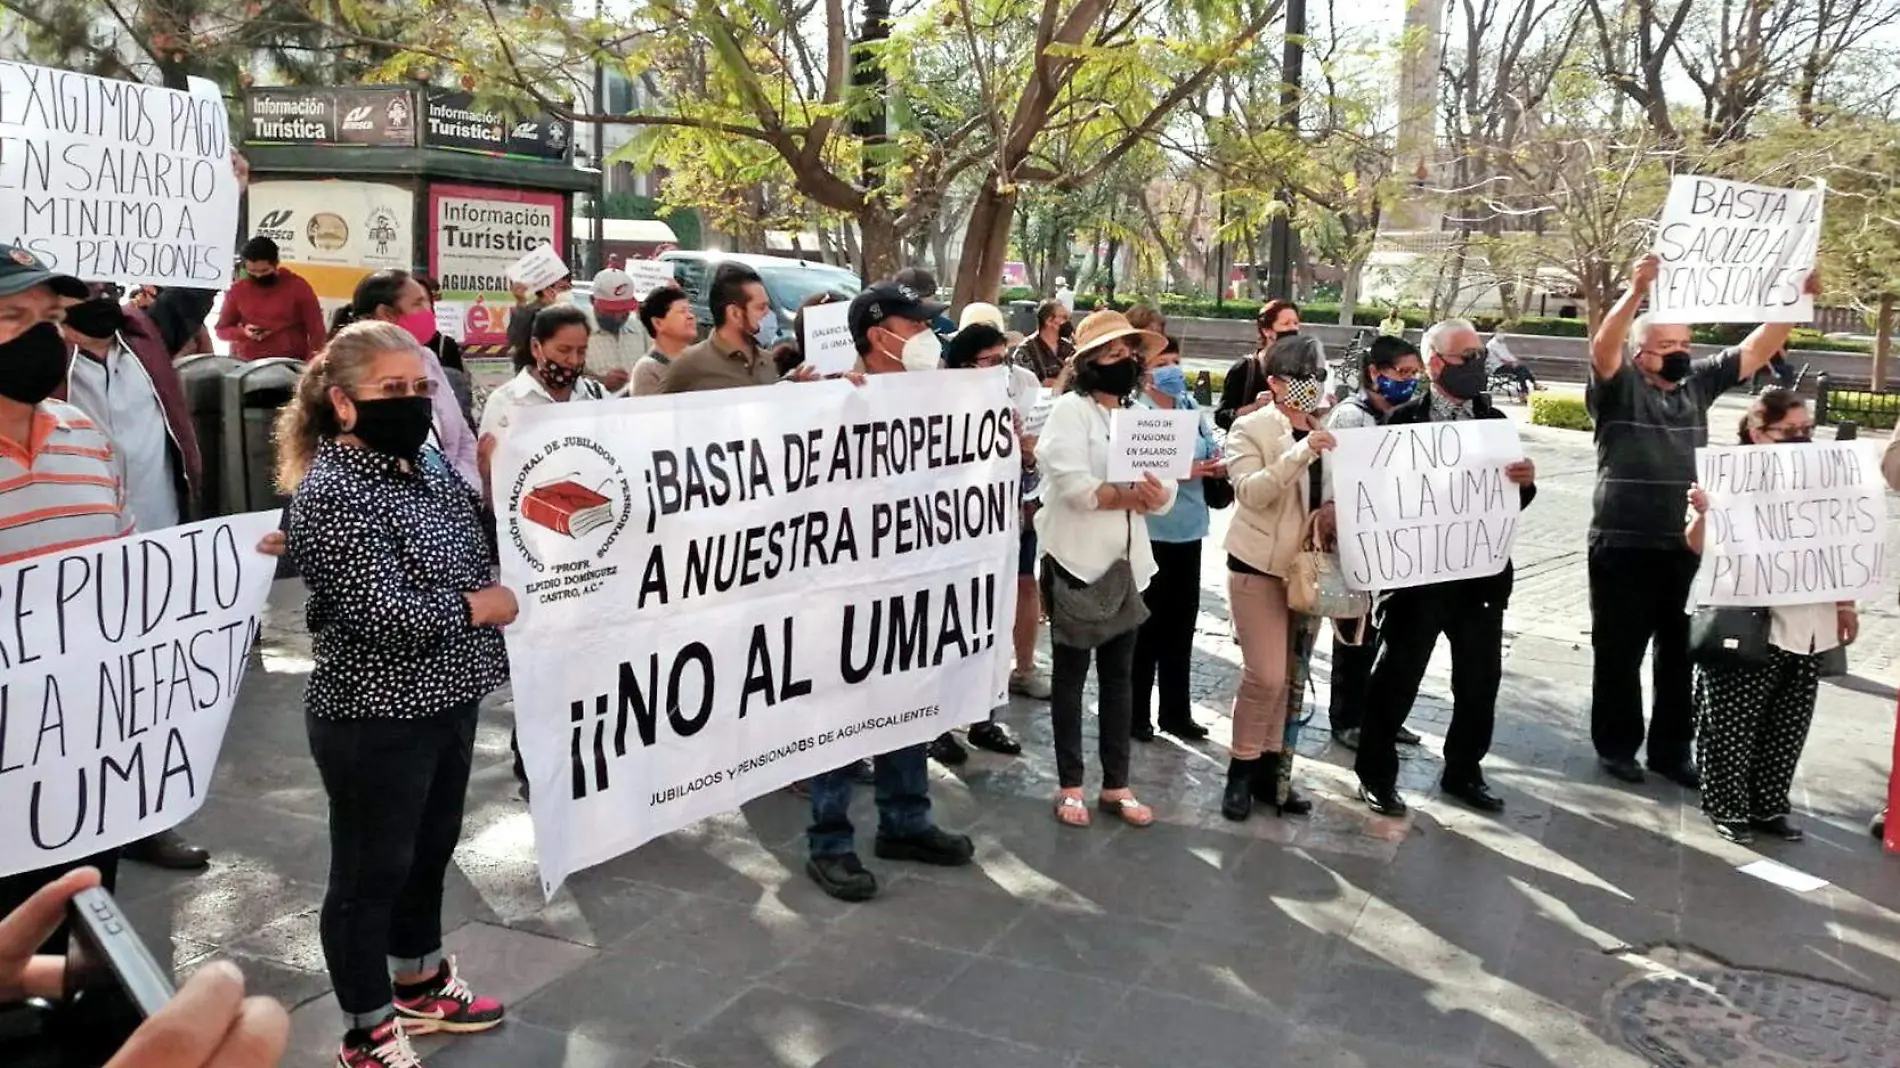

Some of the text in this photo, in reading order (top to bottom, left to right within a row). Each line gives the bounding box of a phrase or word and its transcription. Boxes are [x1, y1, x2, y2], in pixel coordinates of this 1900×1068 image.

[0, 62, 225, 159] EXIGIMOS PAGO
[252, 117, 326, 139] Turística
[253, 97, 325, 115] Información
[0, 138, 214, 202] EN SALARIO
[23, 196, 195, 240] MINIMO A
[445, 202, 550, 227] Información
[1691, 180, 1787, 225] BASTA
[75, 239, 221, 280] PENSIONES
[1661, 222, 1770, 264] SAQUEO
[1761, 229, 1789, 265] A
[1656, 266, 1809, 311] PENSIONES
[1131, 433, 1176, 441] PENSIONES
[1137, 419, 1161, 428] PAGO
[509, 453, 545, 512] NACIONAL
[544, 440, 561, 456] DE
[562, 436, 617, 466] JUBILADOS
[615, 465, 624, 475] Y
[645, 438, 774, 534] ¡BASTA
[783, 428, 823, 493] DE
[827, 407, 1012, 483] ATROPELLOS
[1126, 447, 1177, 456] EN SALARIOS
[1791, 450, 1813, 490] EL
[1819, 448, 1862, 489] UMA
[1356, 467, 1505, 524] A LA UMA
[1711, 496, 1876, 545] DE NUESTRAS
[638, 545, 669, 609] A
[682, 506, 858, 598] NUESTRA
[1354, 517, 1516, 585] JUSTICIA!!
[1710, 542, 1885, 597] PENSIONES!!
[526, 577, 561, 594] ELPIDIO
[0, 615, 257, 773] LA NEFASTA
[570, 574, 995, 800] ¡¡NO AL UMA!!
[650, 772, 723, 806] JUBILADOS
[726, 767, 737, 781] Y
[818, 731, 835, 745] DE
[836, 704, 940, 740] AGUASCALIENTES
[30, 727, 195, 850] UMA
